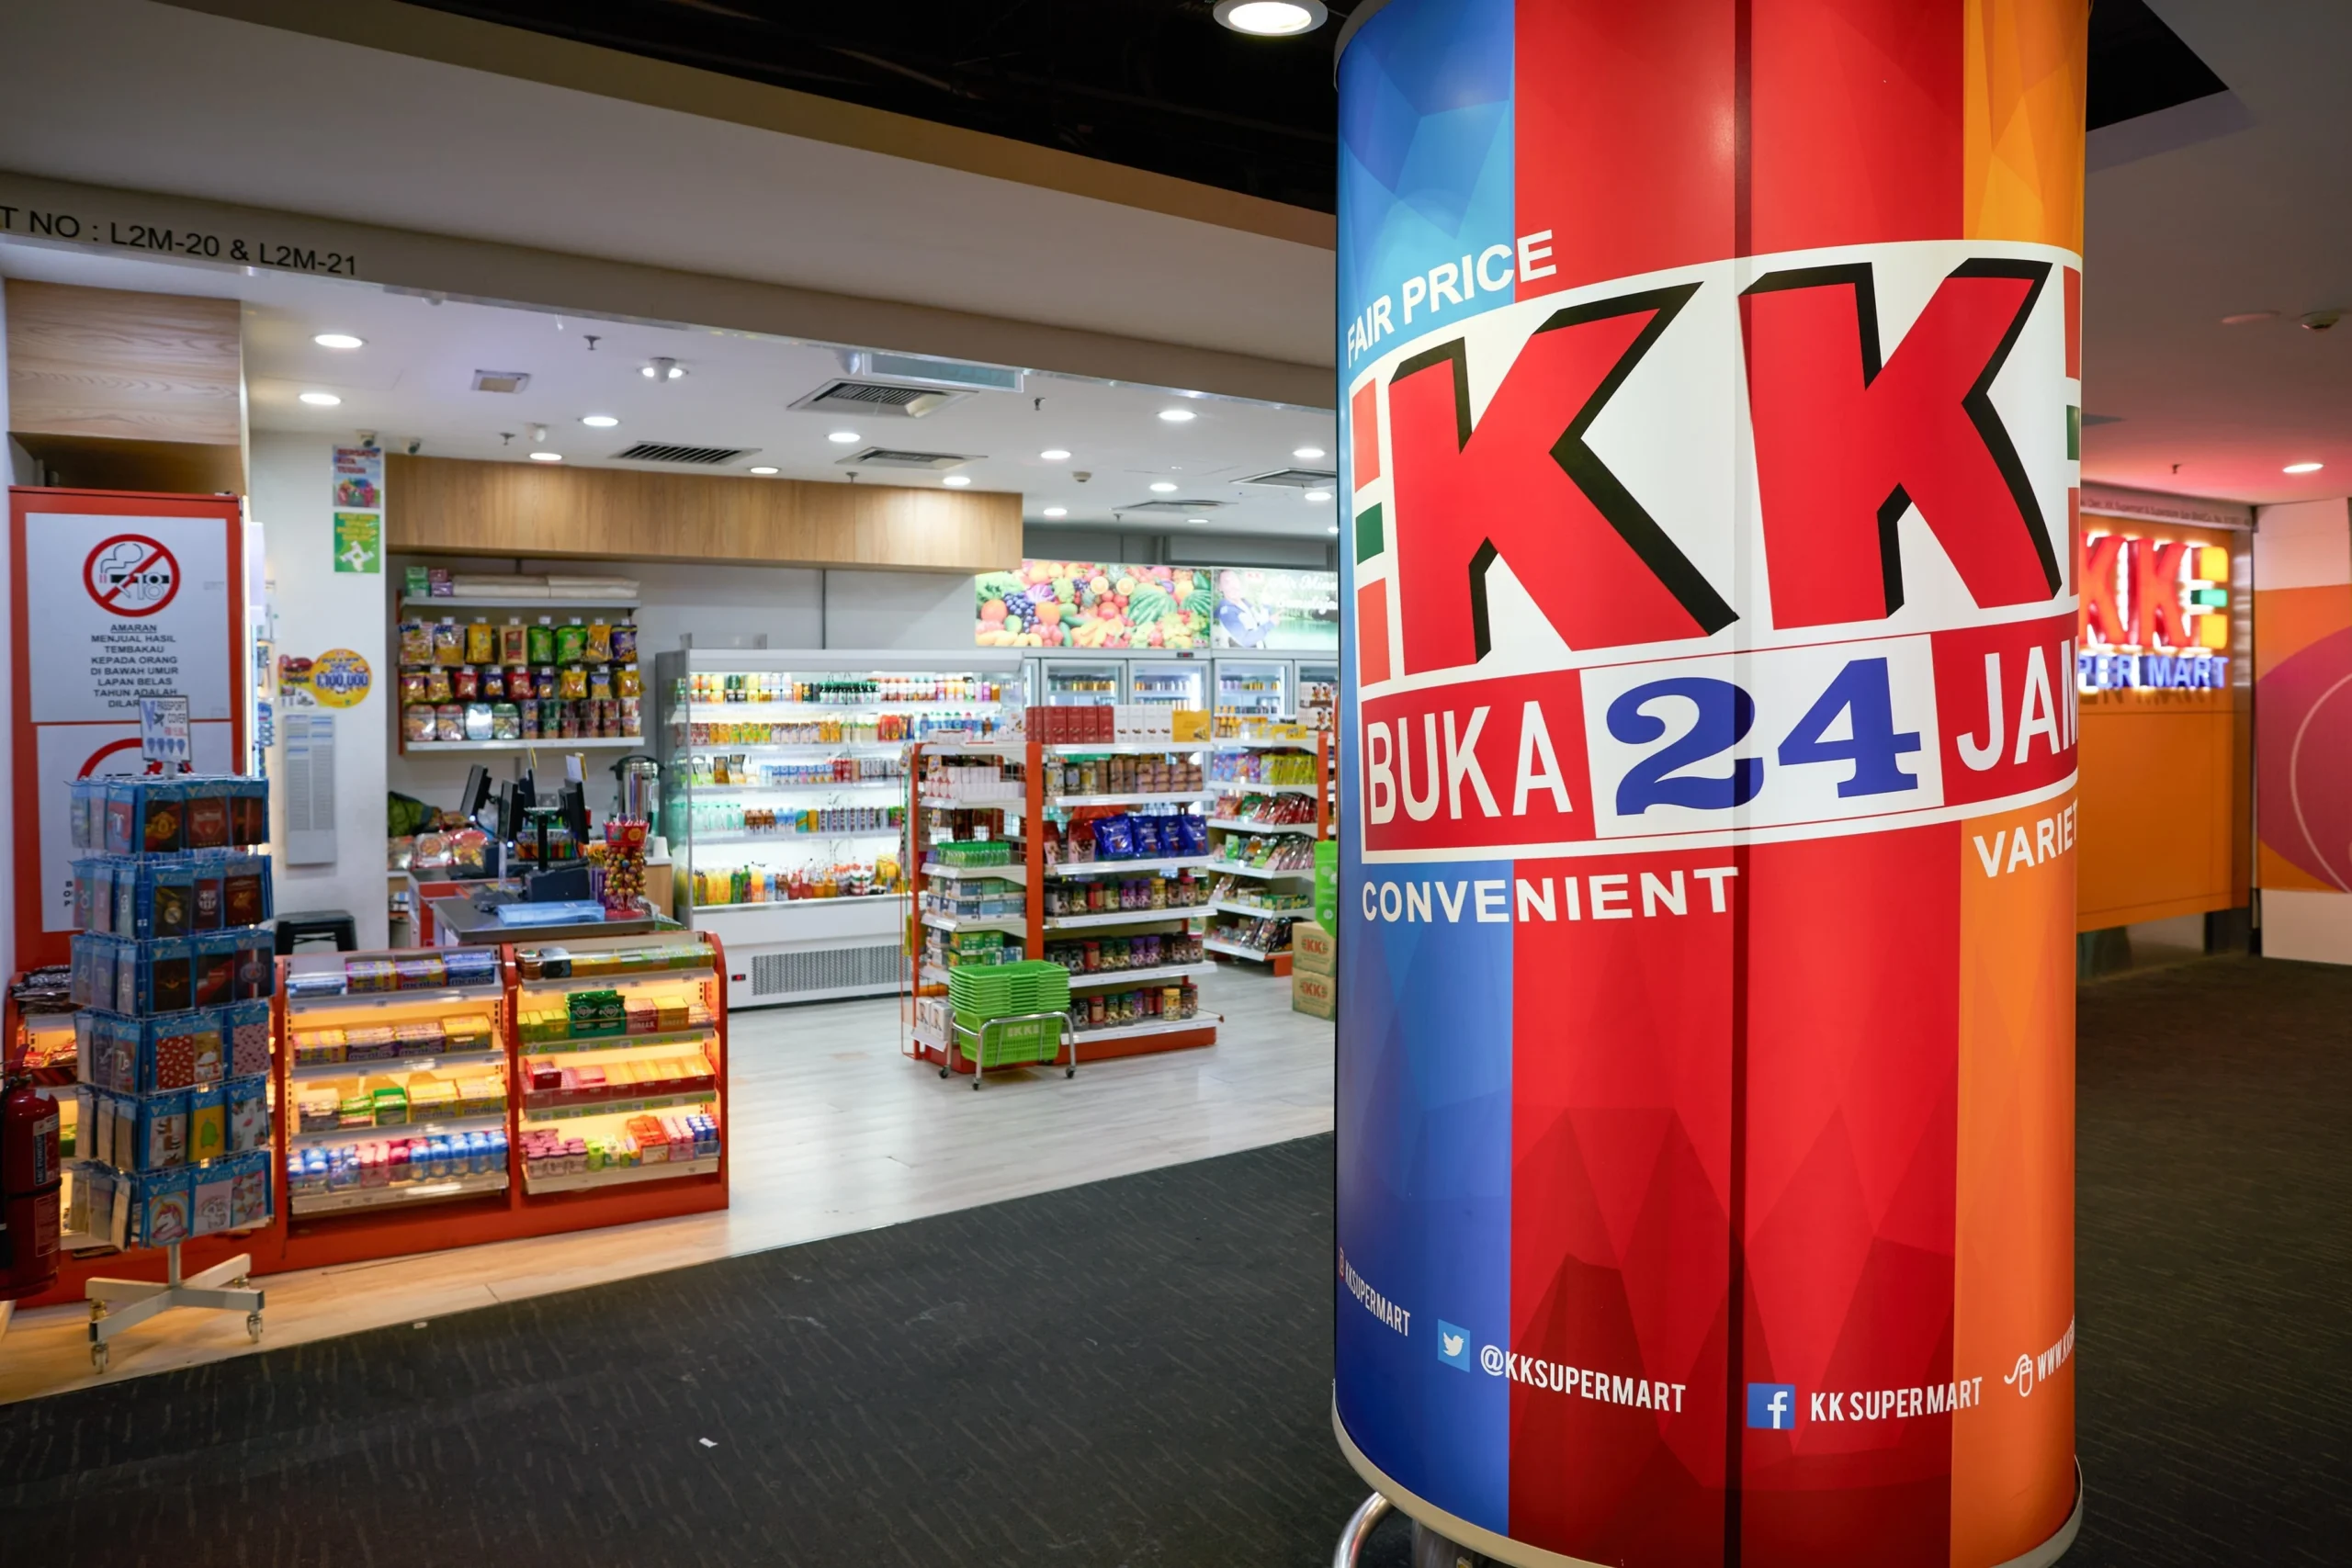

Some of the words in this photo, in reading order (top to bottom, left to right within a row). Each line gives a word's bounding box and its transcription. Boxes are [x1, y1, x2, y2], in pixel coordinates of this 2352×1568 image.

[29, 210, 80, 238] NO
[110, 221, 220, 257] L2M-20
[230, 239, 249, 261] &
[260, 243, 355, 276] L2M-21
[1347, 295, 1395, 369] FAIR
[1402, 230, 1556, 325] PRICE
[1389, 257, 2063, 677] KK
[91, 635, 141, 643] MENJUAL
[145, 635, 175, 643] HASIL
[110, 624, 157, 632] AMARAN
[91, 656, 136, 664] KEPADA
[138, 656, 177, 664] ORANG
[104, 645, 164, 653] TEMBAKAU
[90, 667, 101, 675] DI
[104, 667, 144, 675] BAWAH
[148, 666, 178, 674] UMUR
[97, 678, 134, 686] LAPAN
[137, 677, 173, 685] BELAS
[2147, 656, 2230, 688] MART
[93, 689, 130, 697] TAHUN
[1369, 701, 1572, 826] BUKA
[1606, 657, 1922, 817] 24
[1957, 636, 2078, 772] JAM
[1363, 867, 1738, 924] CONVENIENT
[1346, 1259, 1410, 1337] KKSUPERMART
[1480, 1344, 1686, 1413] @KKSUPERMART
[1811, 1392, 1845, 1422] KK
